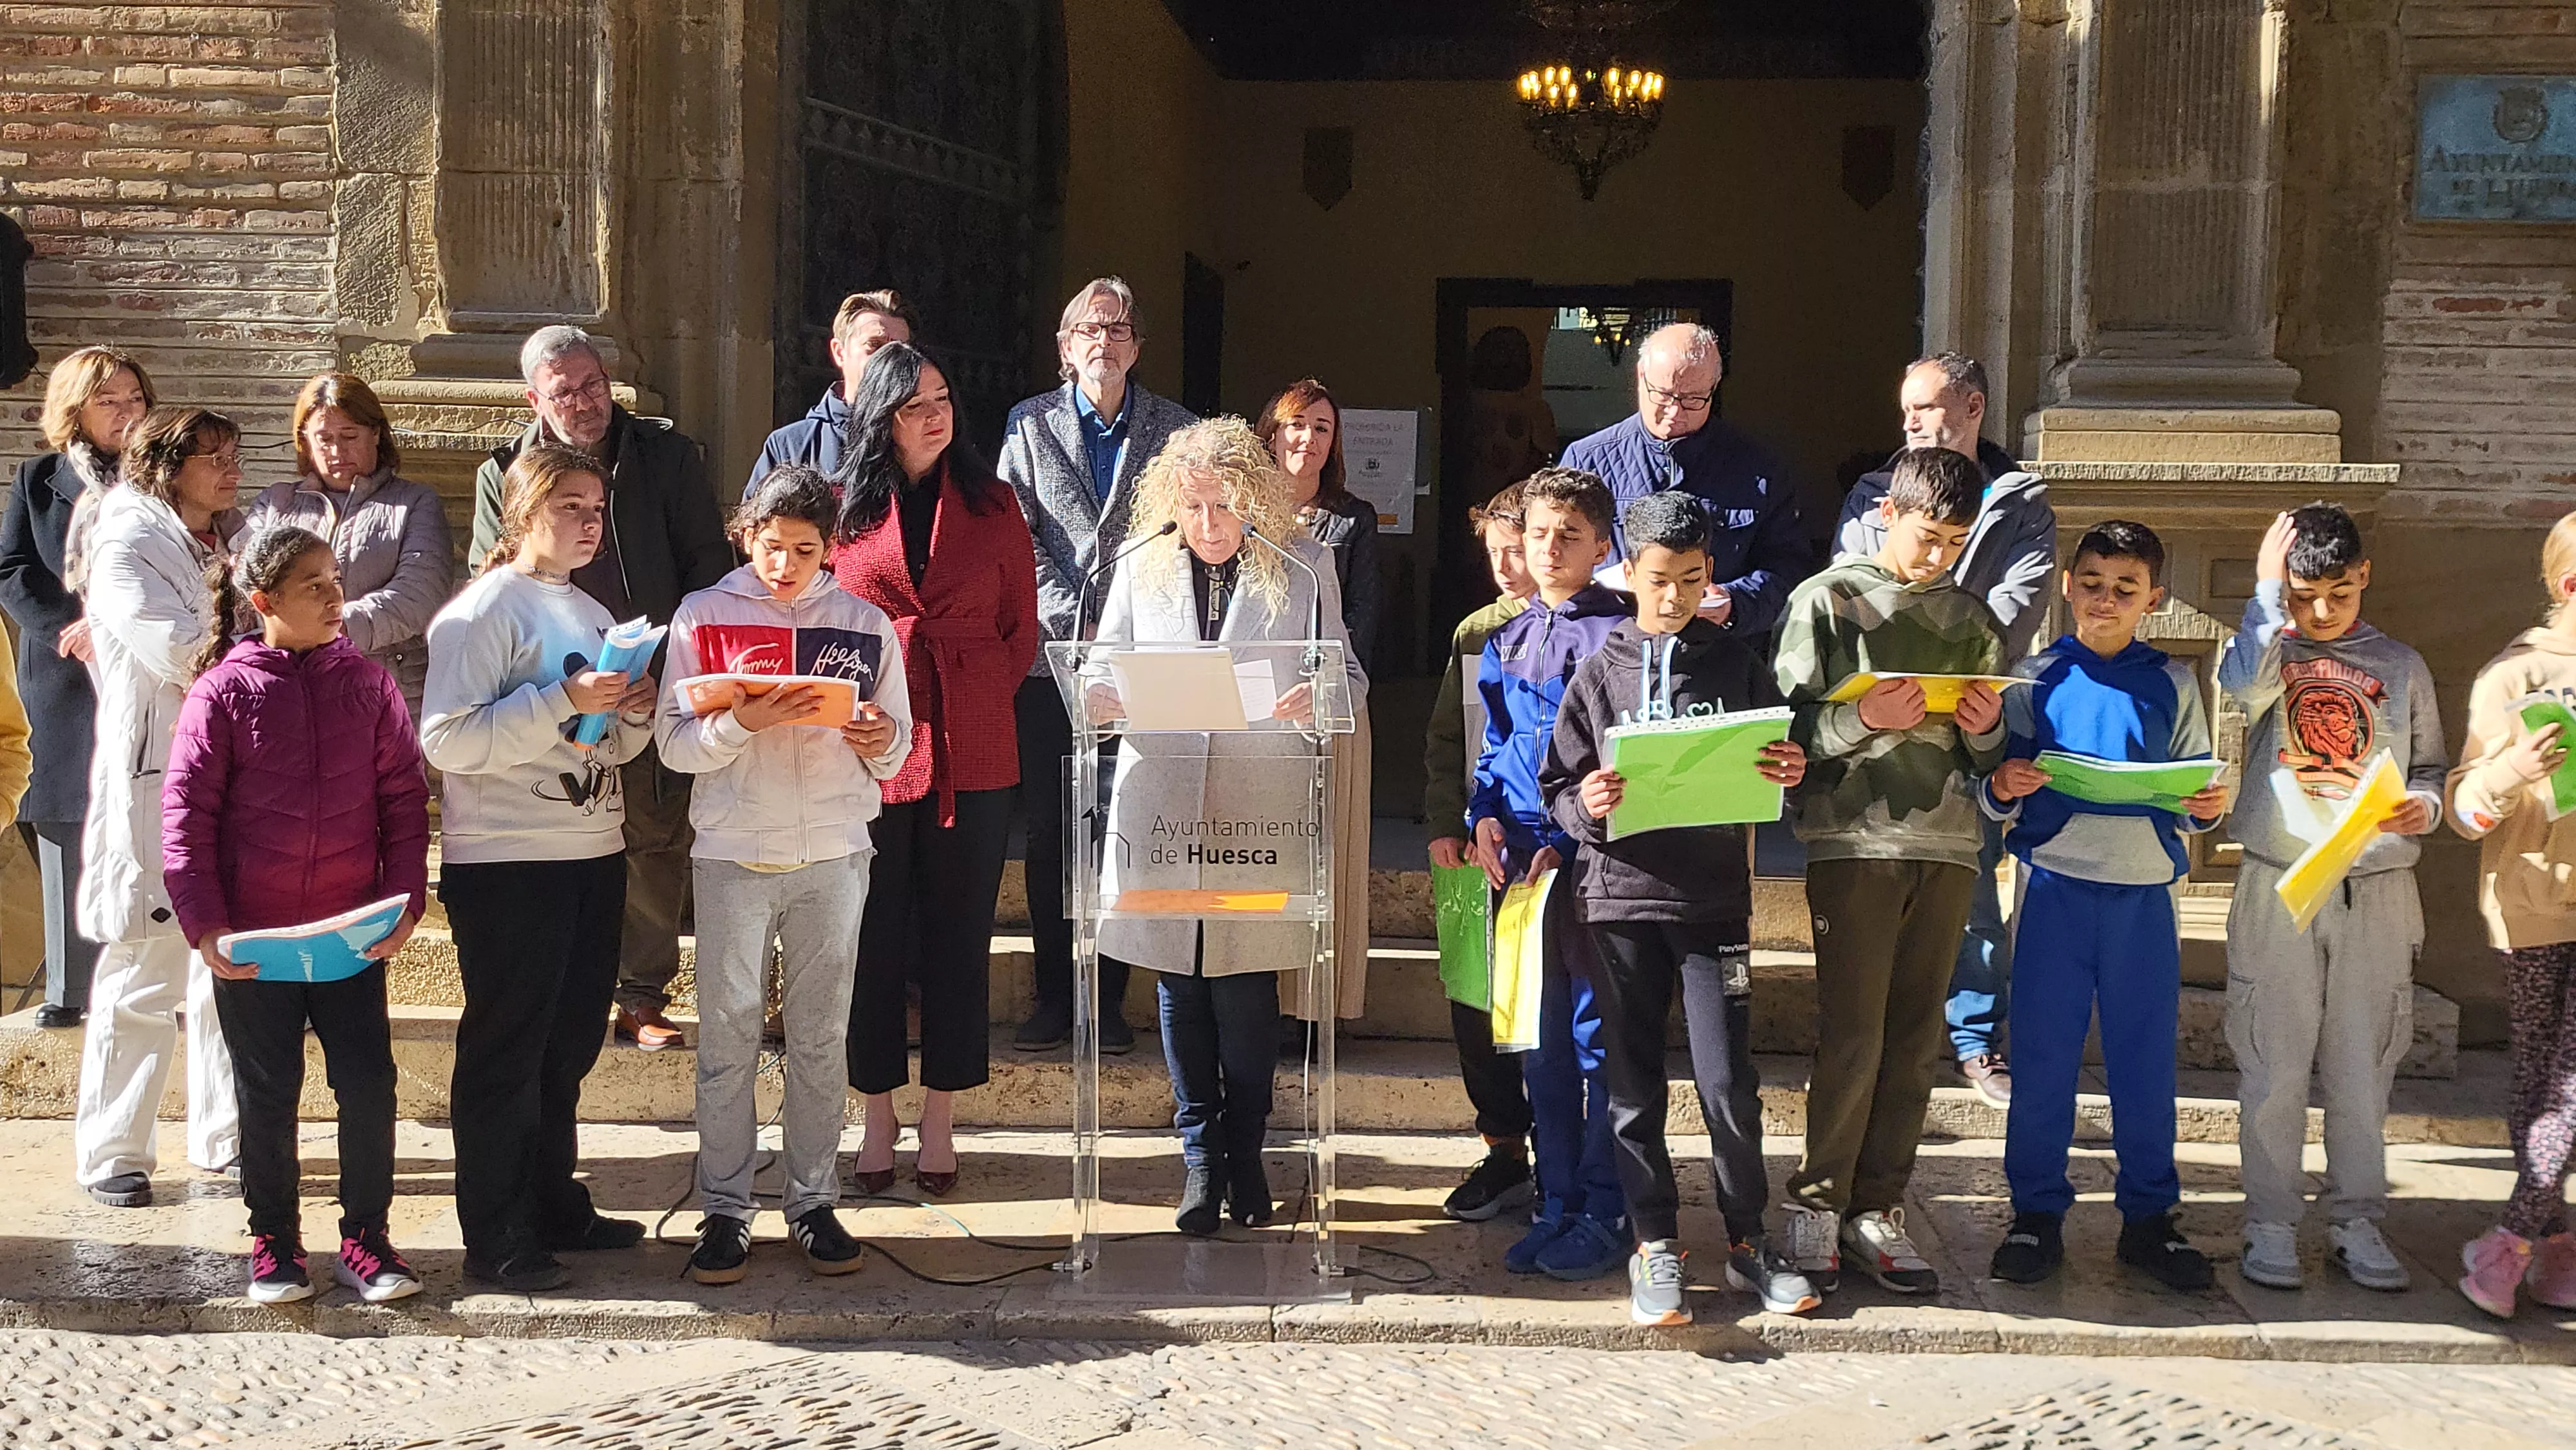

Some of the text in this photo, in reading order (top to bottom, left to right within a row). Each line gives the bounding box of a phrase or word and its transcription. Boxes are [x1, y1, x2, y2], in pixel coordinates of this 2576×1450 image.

[728, 643, 784, 675] Tommy
[1150, 814, 1320, 842] Ayuntamiento
[1150, 843, 1277, 865] de Huesca
